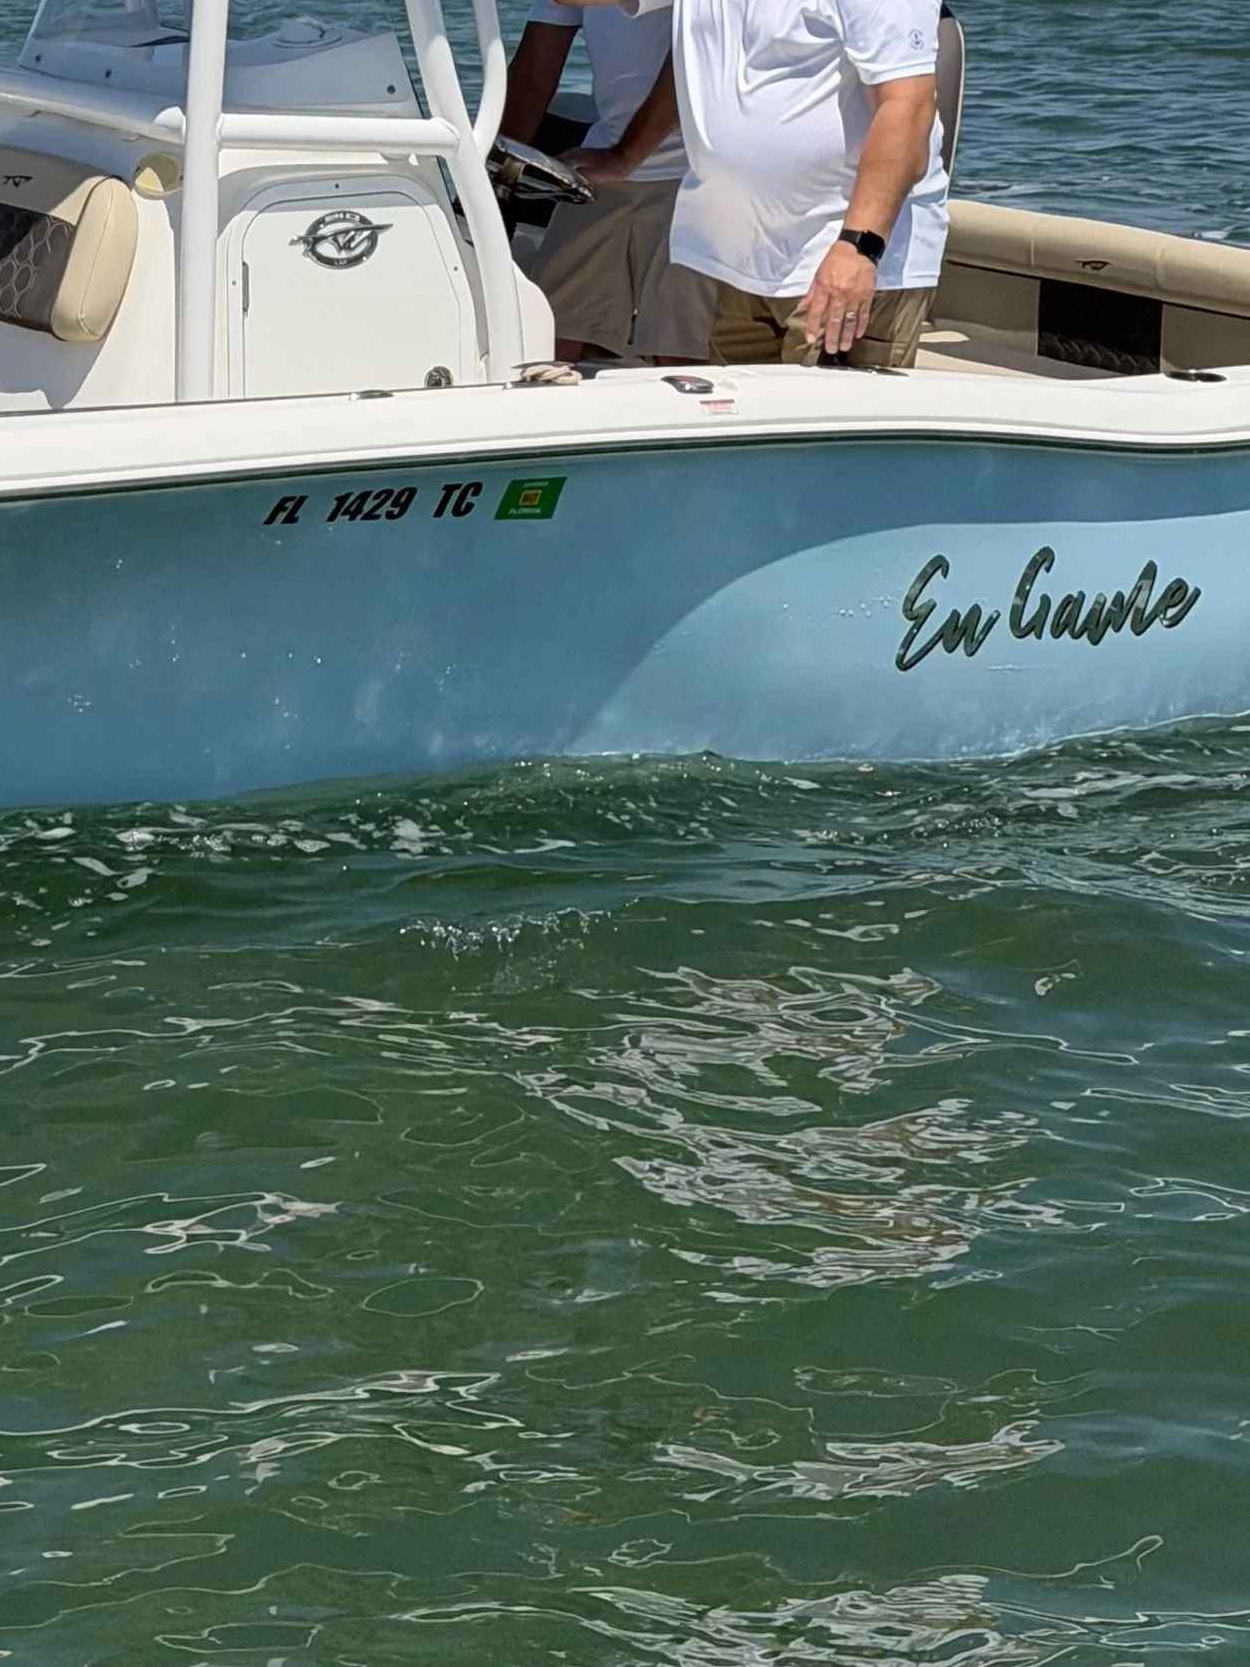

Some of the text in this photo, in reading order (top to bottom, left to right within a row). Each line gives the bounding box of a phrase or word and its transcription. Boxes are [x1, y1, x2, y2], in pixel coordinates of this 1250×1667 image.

[262, 482, 484, 525] FL 1429 TC
[895, 554, 1001, 671] En
